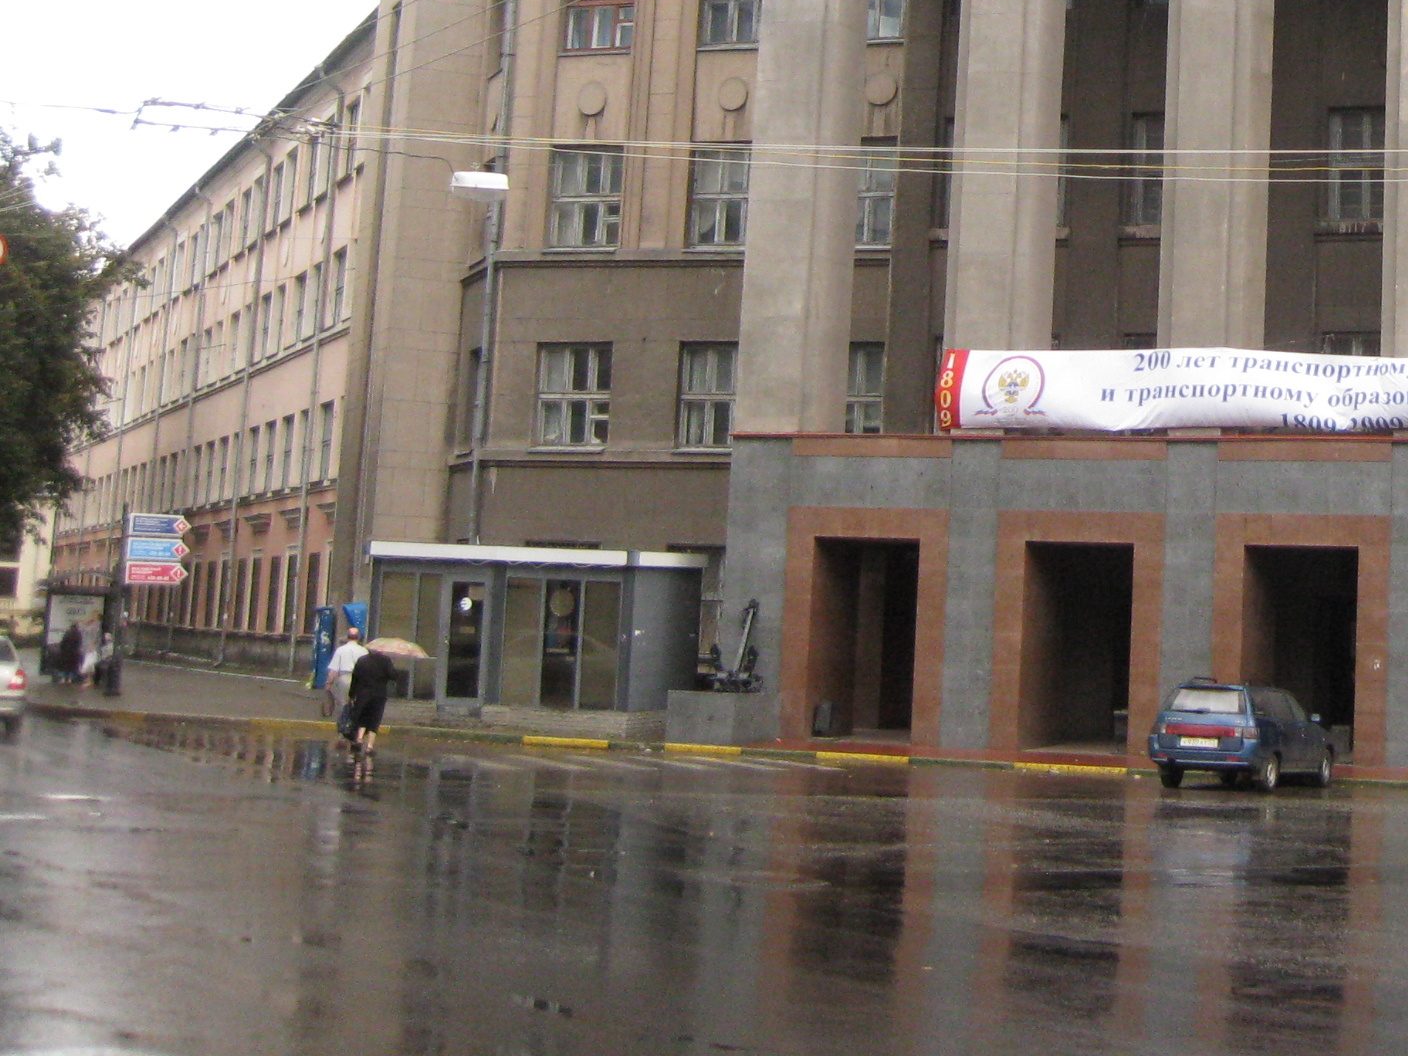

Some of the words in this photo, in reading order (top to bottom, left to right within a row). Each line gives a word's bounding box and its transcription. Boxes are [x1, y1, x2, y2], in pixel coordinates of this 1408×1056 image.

[1133, 350, 1171, 372] 200
[1176, 354, 1221, 369] лет
[940, 352, 956, 427] 1809
[1100, 387, 1116, 402] и
[1124, 382, 1319, 408] транспортному
